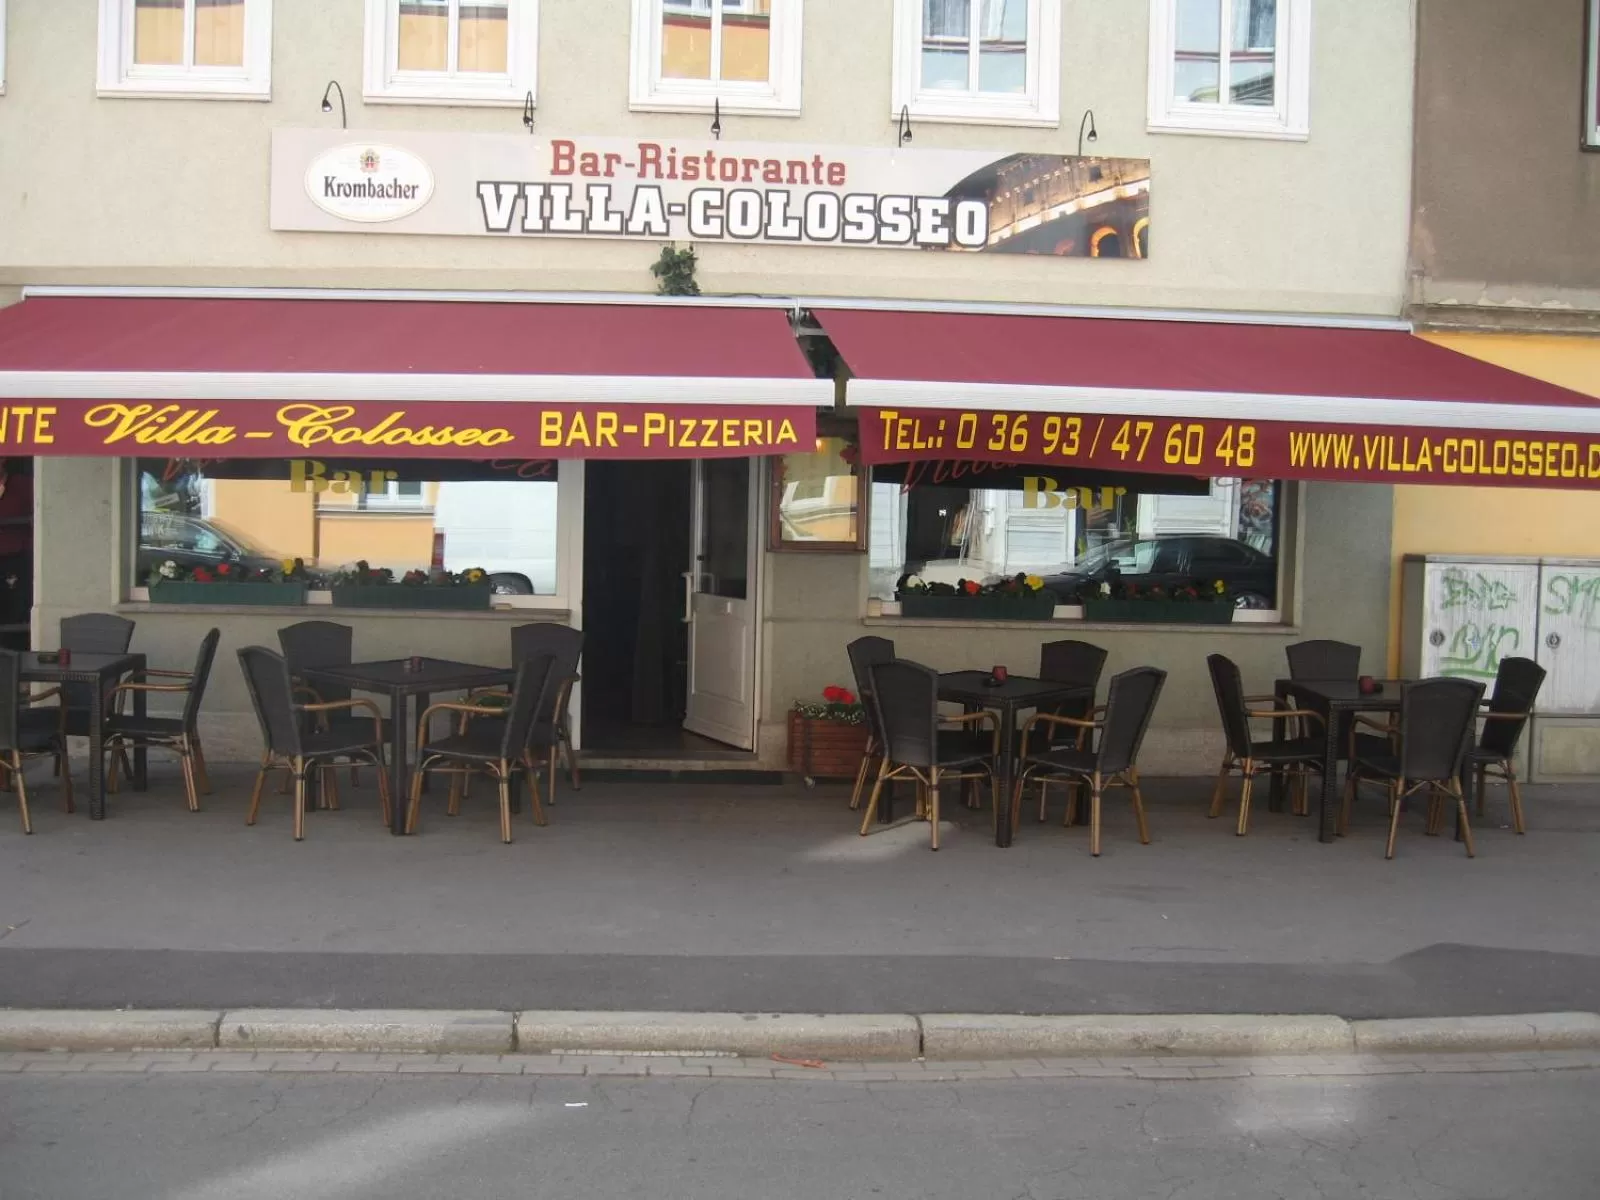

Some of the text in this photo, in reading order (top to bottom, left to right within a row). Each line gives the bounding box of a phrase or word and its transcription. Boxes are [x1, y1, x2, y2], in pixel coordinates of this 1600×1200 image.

[550, 139, 846, 187] Bar-Ristorante
[323, 175, 420, 200] Krombacher
[476, 179, 990, 251] VILLA-COLOSSEO
[83, 403, 237, 445] Villa
[275, 403, 515, 449] Colosseo
[988, 414, 1029, 452] 36
[1110, 420, 1155, 462] 47
[1163, 423, 1204, 465] 60
[1214, 425, 1257, 467] 48
[285, 459, 399, 493] Bar
[1018, 476, 1127, 510] Bar
